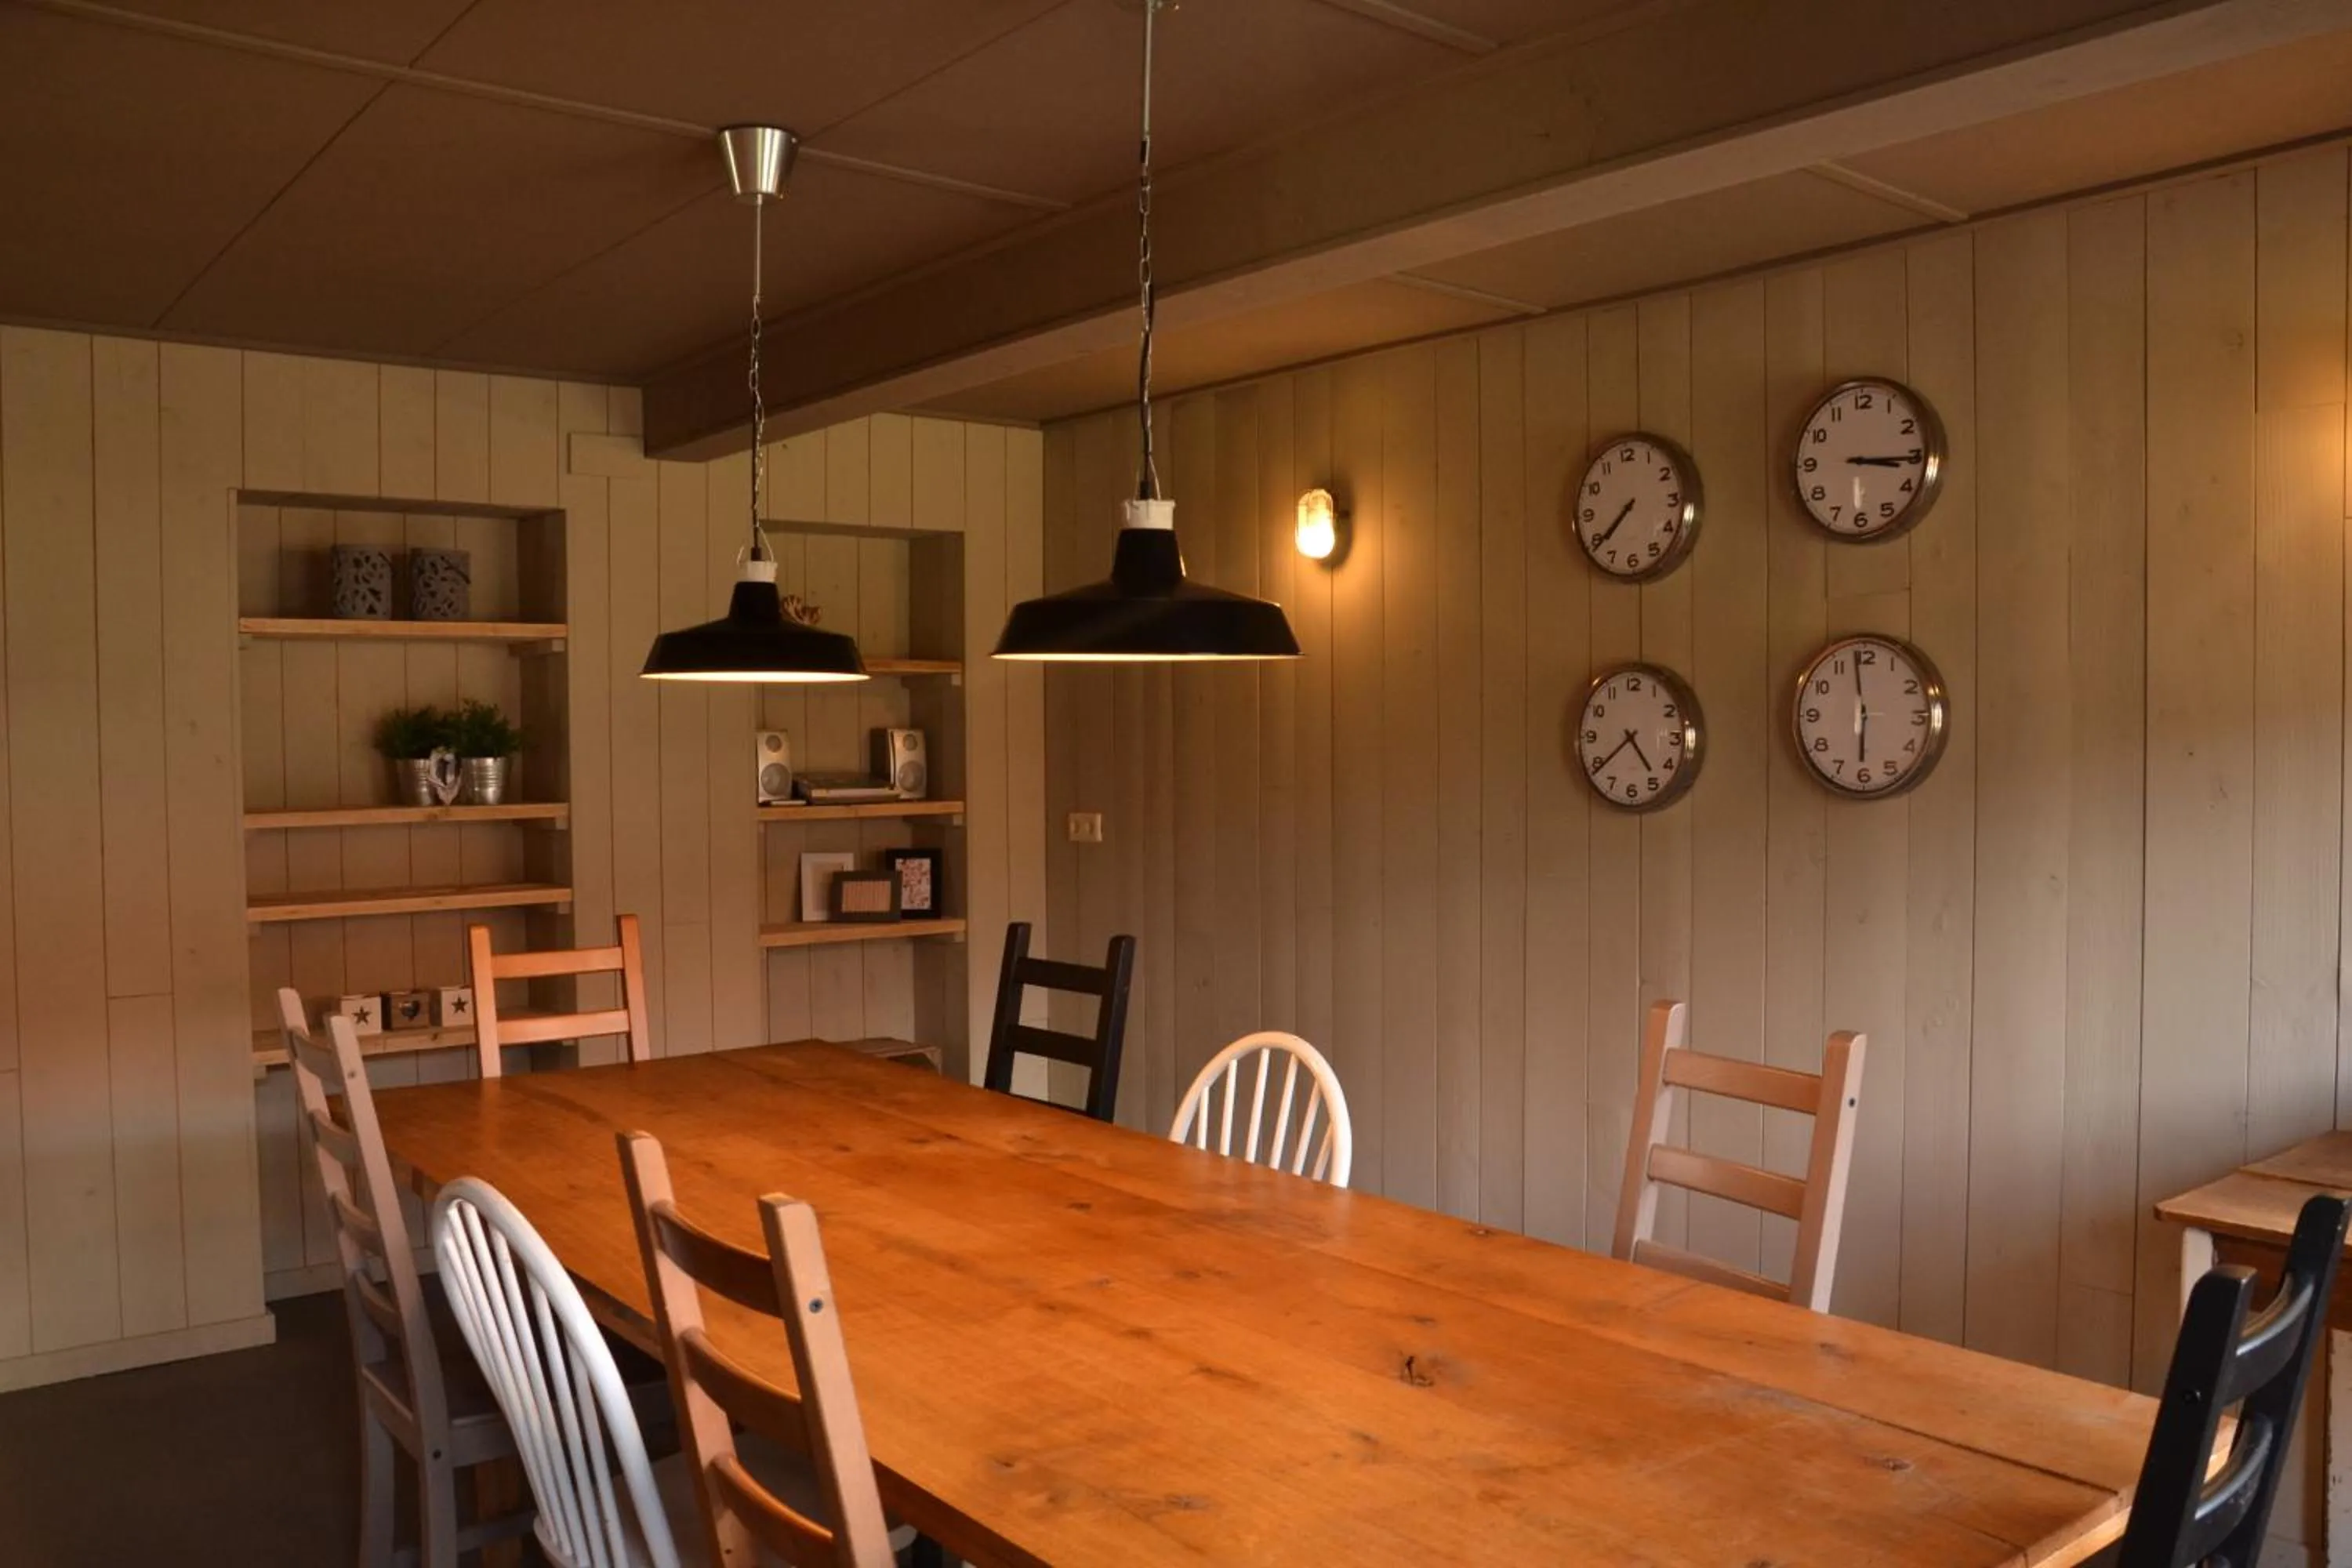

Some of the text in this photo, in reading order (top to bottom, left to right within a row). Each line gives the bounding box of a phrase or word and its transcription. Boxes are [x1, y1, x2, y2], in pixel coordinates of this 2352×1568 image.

[1855, 395, 1873, 410] 12
[1831, 407, 1841, 423] 11
[1900, 419, 1914, 434] 2
[1813, 429, 1827, 444] 10
[1621, 448, 1635, 463] 12
[1908, 448, 1921, 464] 3
[1602, 462, 1610, 475] 11
[1804, 458, 1817, 472] 9
[1659, 467, 1670, 481] 2
[1589, 481, 1600, 495] 10
[1900, 478, 1913, 492] 4
[1668, 493, 1679, 507] 3
[1811, 486, 1825, 500] 8
[1583, 508, 1594, 522] 9
[1830, 506, 1842, 521] 7
[1881, 503, 1894, 517] 5
[1664, 519, 1673, 532] 4
[1853, 513, 1867, 527] 6
[1592, 533, 1603, 546] 8
[1607, 550, 1617, 564] 7
[1648, 543, 1660, 557] 5
[1627, 554, 1639, 568] 6
[1857, 651, 1875, 665] 12
[1834, 661, 1844, 674] 11
[1627, 678, 1641, 691] 12
[1816, 680, 1829, 695] 10
[1904, 680, 1918, 694] 2
[1608, 687, 1616, 699] 11
[1593, 705, 1604, 717] 10
[1664, 705, 1675, 717] 2
[1806, 709, 1820, 722] 9
[1911, 710, 1926, 726] 3
[1586, 731, 1596, 743] 9
[1669, 731, 1681, 746] 3
[1814, 738, 1828, 752] 8
[1903, 739, 1915, 753] 4
[1592, 757, 1603, 771] 8
[1663, 758, 1673, 770] 4
[1832, 759, 1844, 774] 7
[1883, 761, 1897, 775] 5
[1857, 768, 1871, 783] 6
[1607, 777, 1617, 790] 7
[1626, 784, 1638, 797] 6
[1647, 778, 1659, 790] 5
